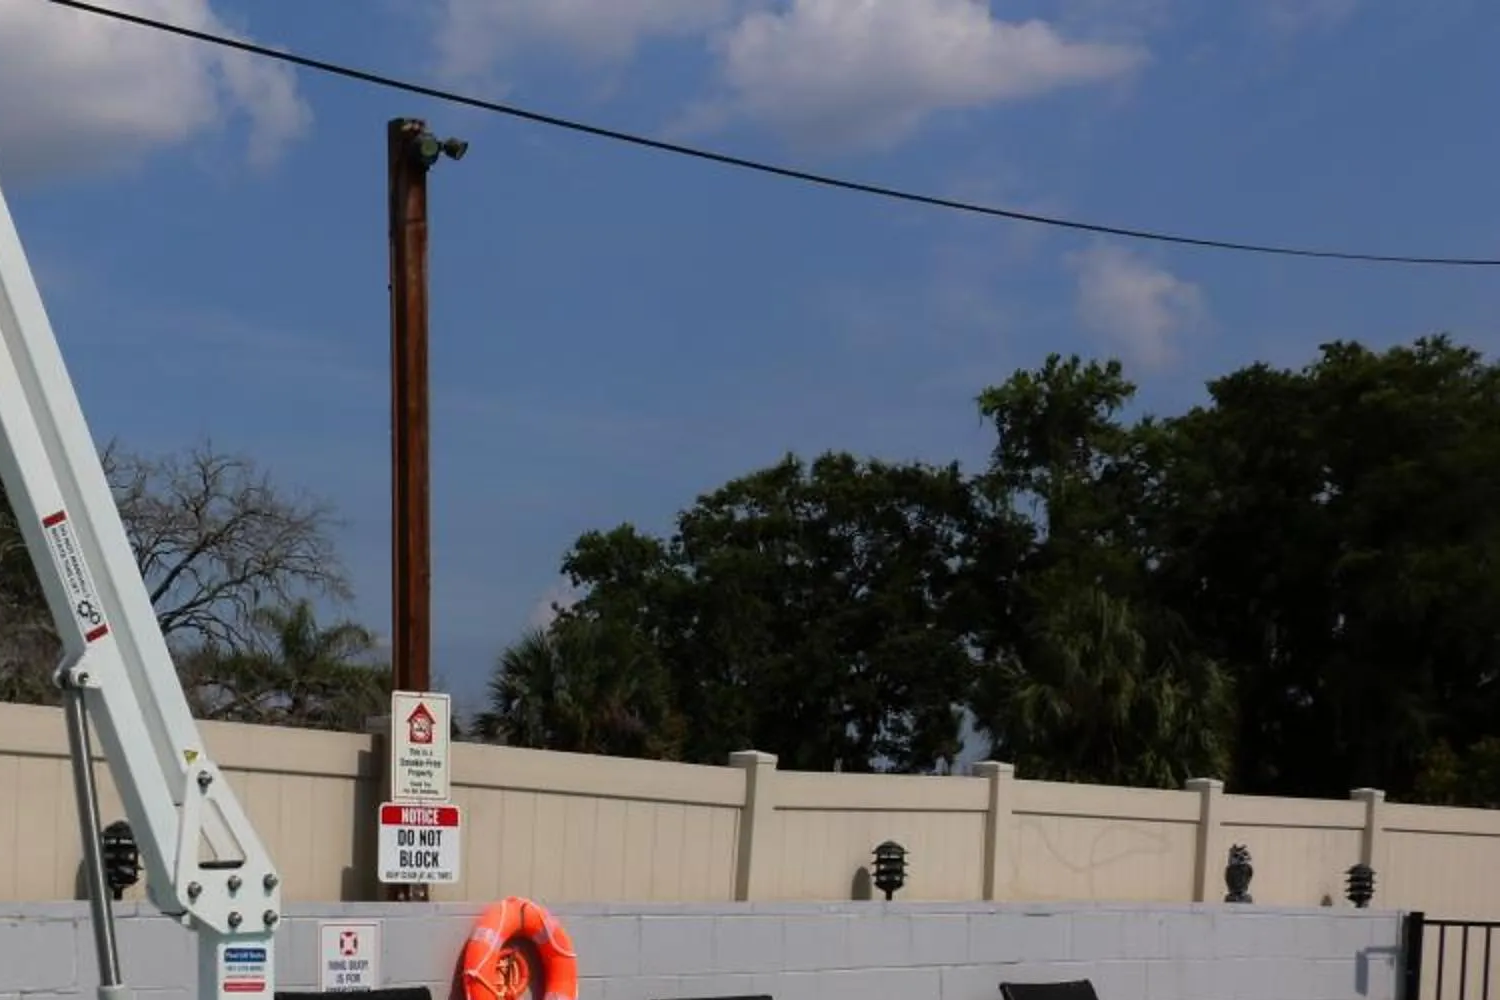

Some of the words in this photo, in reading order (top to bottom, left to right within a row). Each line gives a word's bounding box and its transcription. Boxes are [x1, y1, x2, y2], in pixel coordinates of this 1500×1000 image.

[401, 808, 440, 825] NOTICE
[397, 829, 415, 847] DO
[419, 829, 443, 847] NOT
[399, 850, 440, 868] BLOCK
